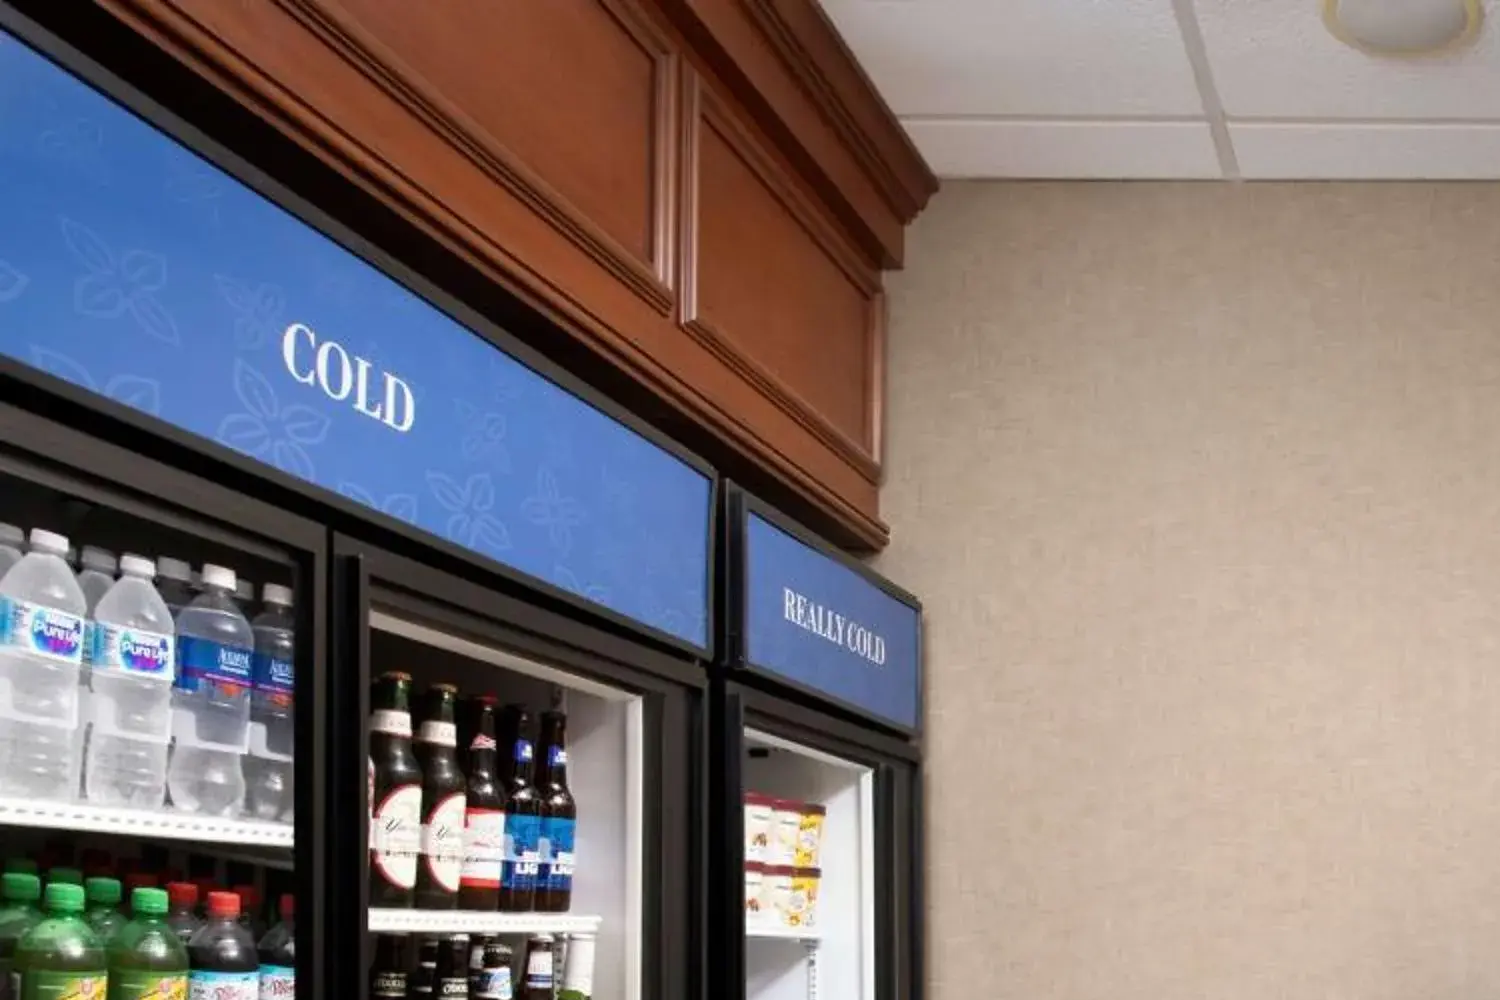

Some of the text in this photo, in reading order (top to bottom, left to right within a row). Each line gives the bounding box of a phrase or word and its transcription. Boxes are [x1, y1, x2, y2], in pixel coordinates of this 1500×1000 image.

[283, 323, 415, 433] COLD
[783, 586, 886, 665] REALLY COLD
